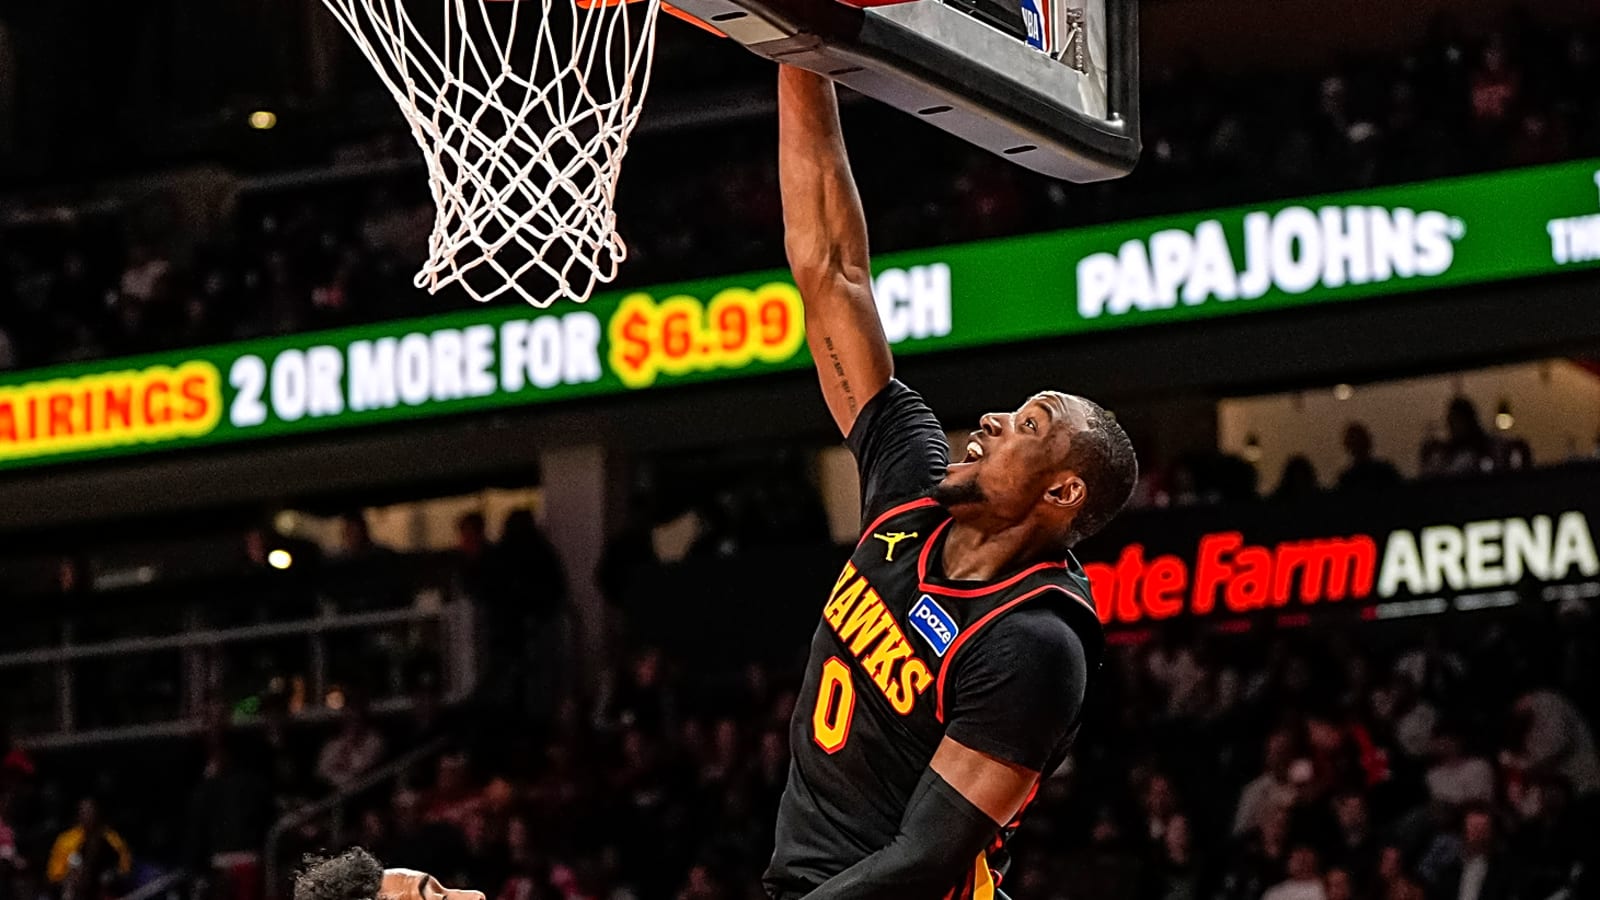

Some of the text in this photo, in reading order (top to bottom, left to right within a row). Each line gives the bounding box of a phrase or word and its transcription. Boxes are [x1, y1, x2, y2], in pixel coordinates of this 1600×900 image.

[1076, 218, 1238, 318] PAPA
[230, 355, 267, 427] 2
[271, 345, 344, 420] OR
[348, 324, 497, 412] MORE
[501, 310, 602, 392] FOR
[616, 292, 796, 376] $6.99
[870, 262, 952, 344] CH
[1191, 531, 1377, 614] Farm
[1378, 511, 1599, 597] ARENA
[915, 604, 951, 644] paze
[813, 655, 856, 755] 0
